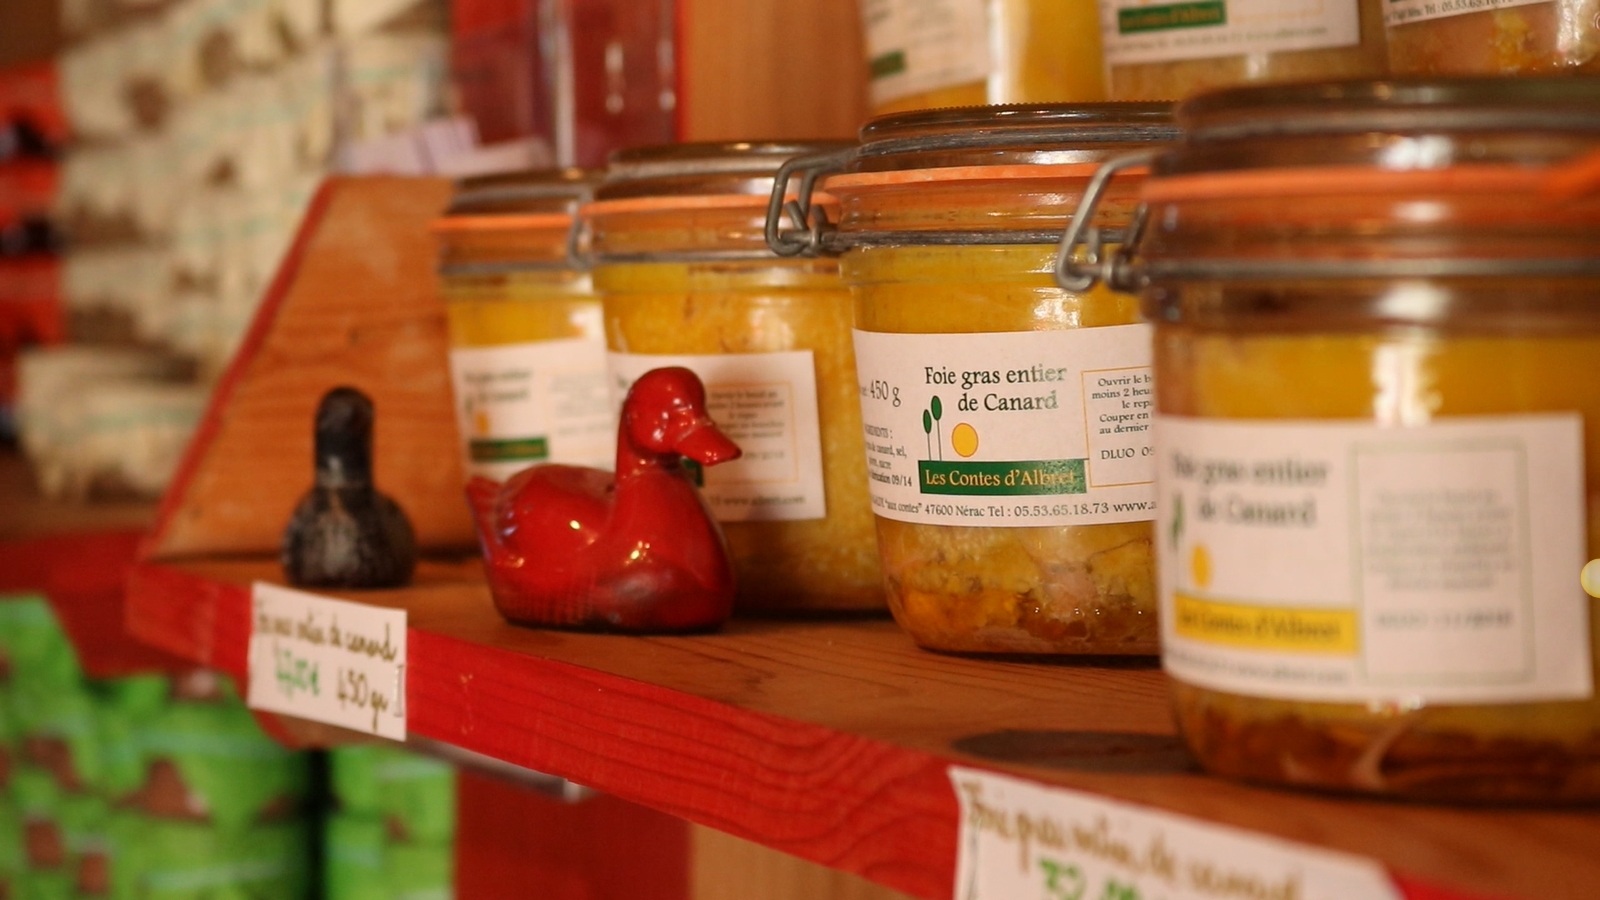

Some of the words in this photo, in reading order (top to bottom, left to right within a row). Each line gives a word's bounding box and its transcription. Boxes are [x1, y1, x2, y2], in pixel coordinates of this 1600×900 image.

[925, 366, 957, 385] Foie
[961, 369, 1001, 389] gras
[1006, 363, 1067, 384] entier
[1098, 375, 1132, 387] Ouvrir
[1133, 374, 1143, 384] le
[870, 380, 890, 400] 450
[892, 387, 902, 407] g
[1091, 389, 1121, 400] moins
[1123, 388, 1130, 398] 2
[1132, 387, 1153, 397] heu
[957, 393, 979, 412] de
[984, 390, 1059, 412] Canard
[1121, 399, 1131, 410] le
[1099, 412, 1135, 424] Couper
[1136, 411, 1150, 421] en
[1099, 426, 1112, 435] au
[1114, 422, 1150, 434] dernier
[1101, 447, 1136, 460] DLUO
[891, 474, 913, 487] 09/14
[925, 470, 946, 486] Les
[950, 470, 1001, 487] Contes
[1004, 469, 1077, 486] d'Albret
[924, 503, 953, 517] 47600
[956, 504, 985, 517] Nérac
[987, 505, 1005, 517] Tel
[1013, 502, 1109, 517] 05.53.65.18.73
